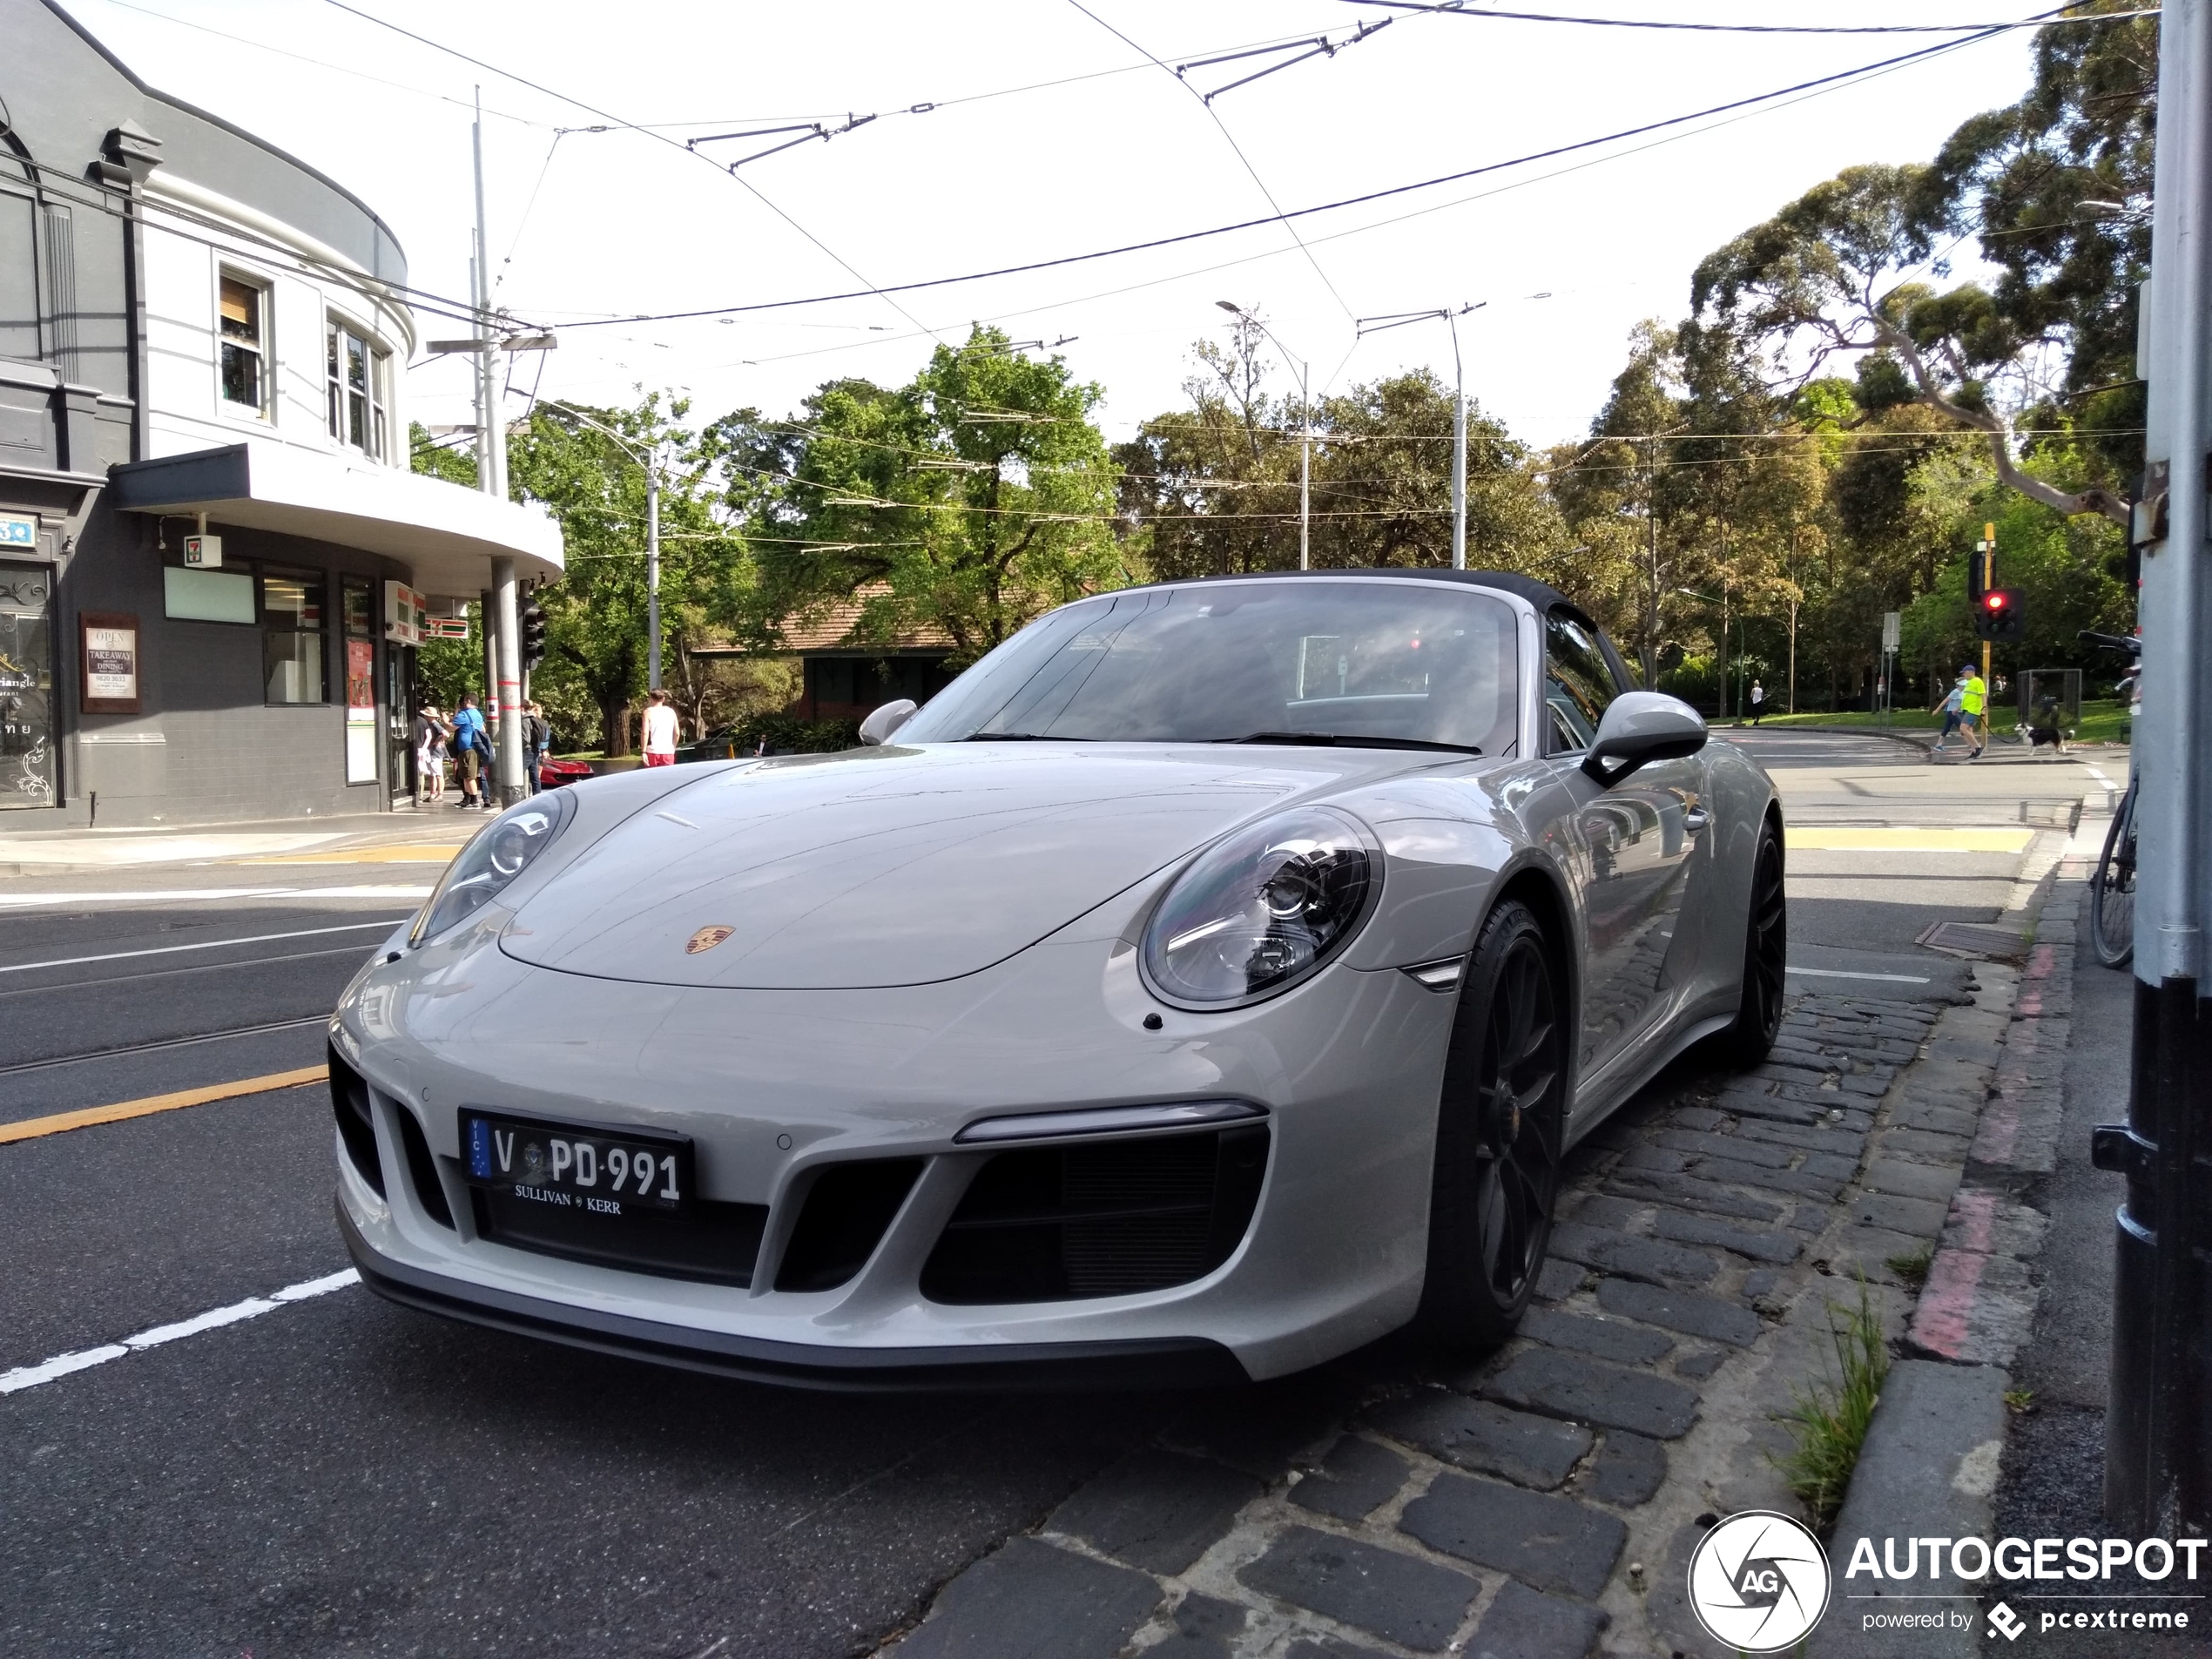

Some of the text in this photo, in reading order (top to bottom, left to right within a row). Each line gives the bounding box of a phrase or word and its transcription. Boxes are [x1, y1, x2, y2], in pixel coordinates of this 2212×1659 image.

[96, 631, 124, 642] OPEN
[90, 651, 132, 660] TAKEAWAY
[495, 1130, 515, 1173] V
[515, 1184, 622, 1215] SULLIVAN KERR
